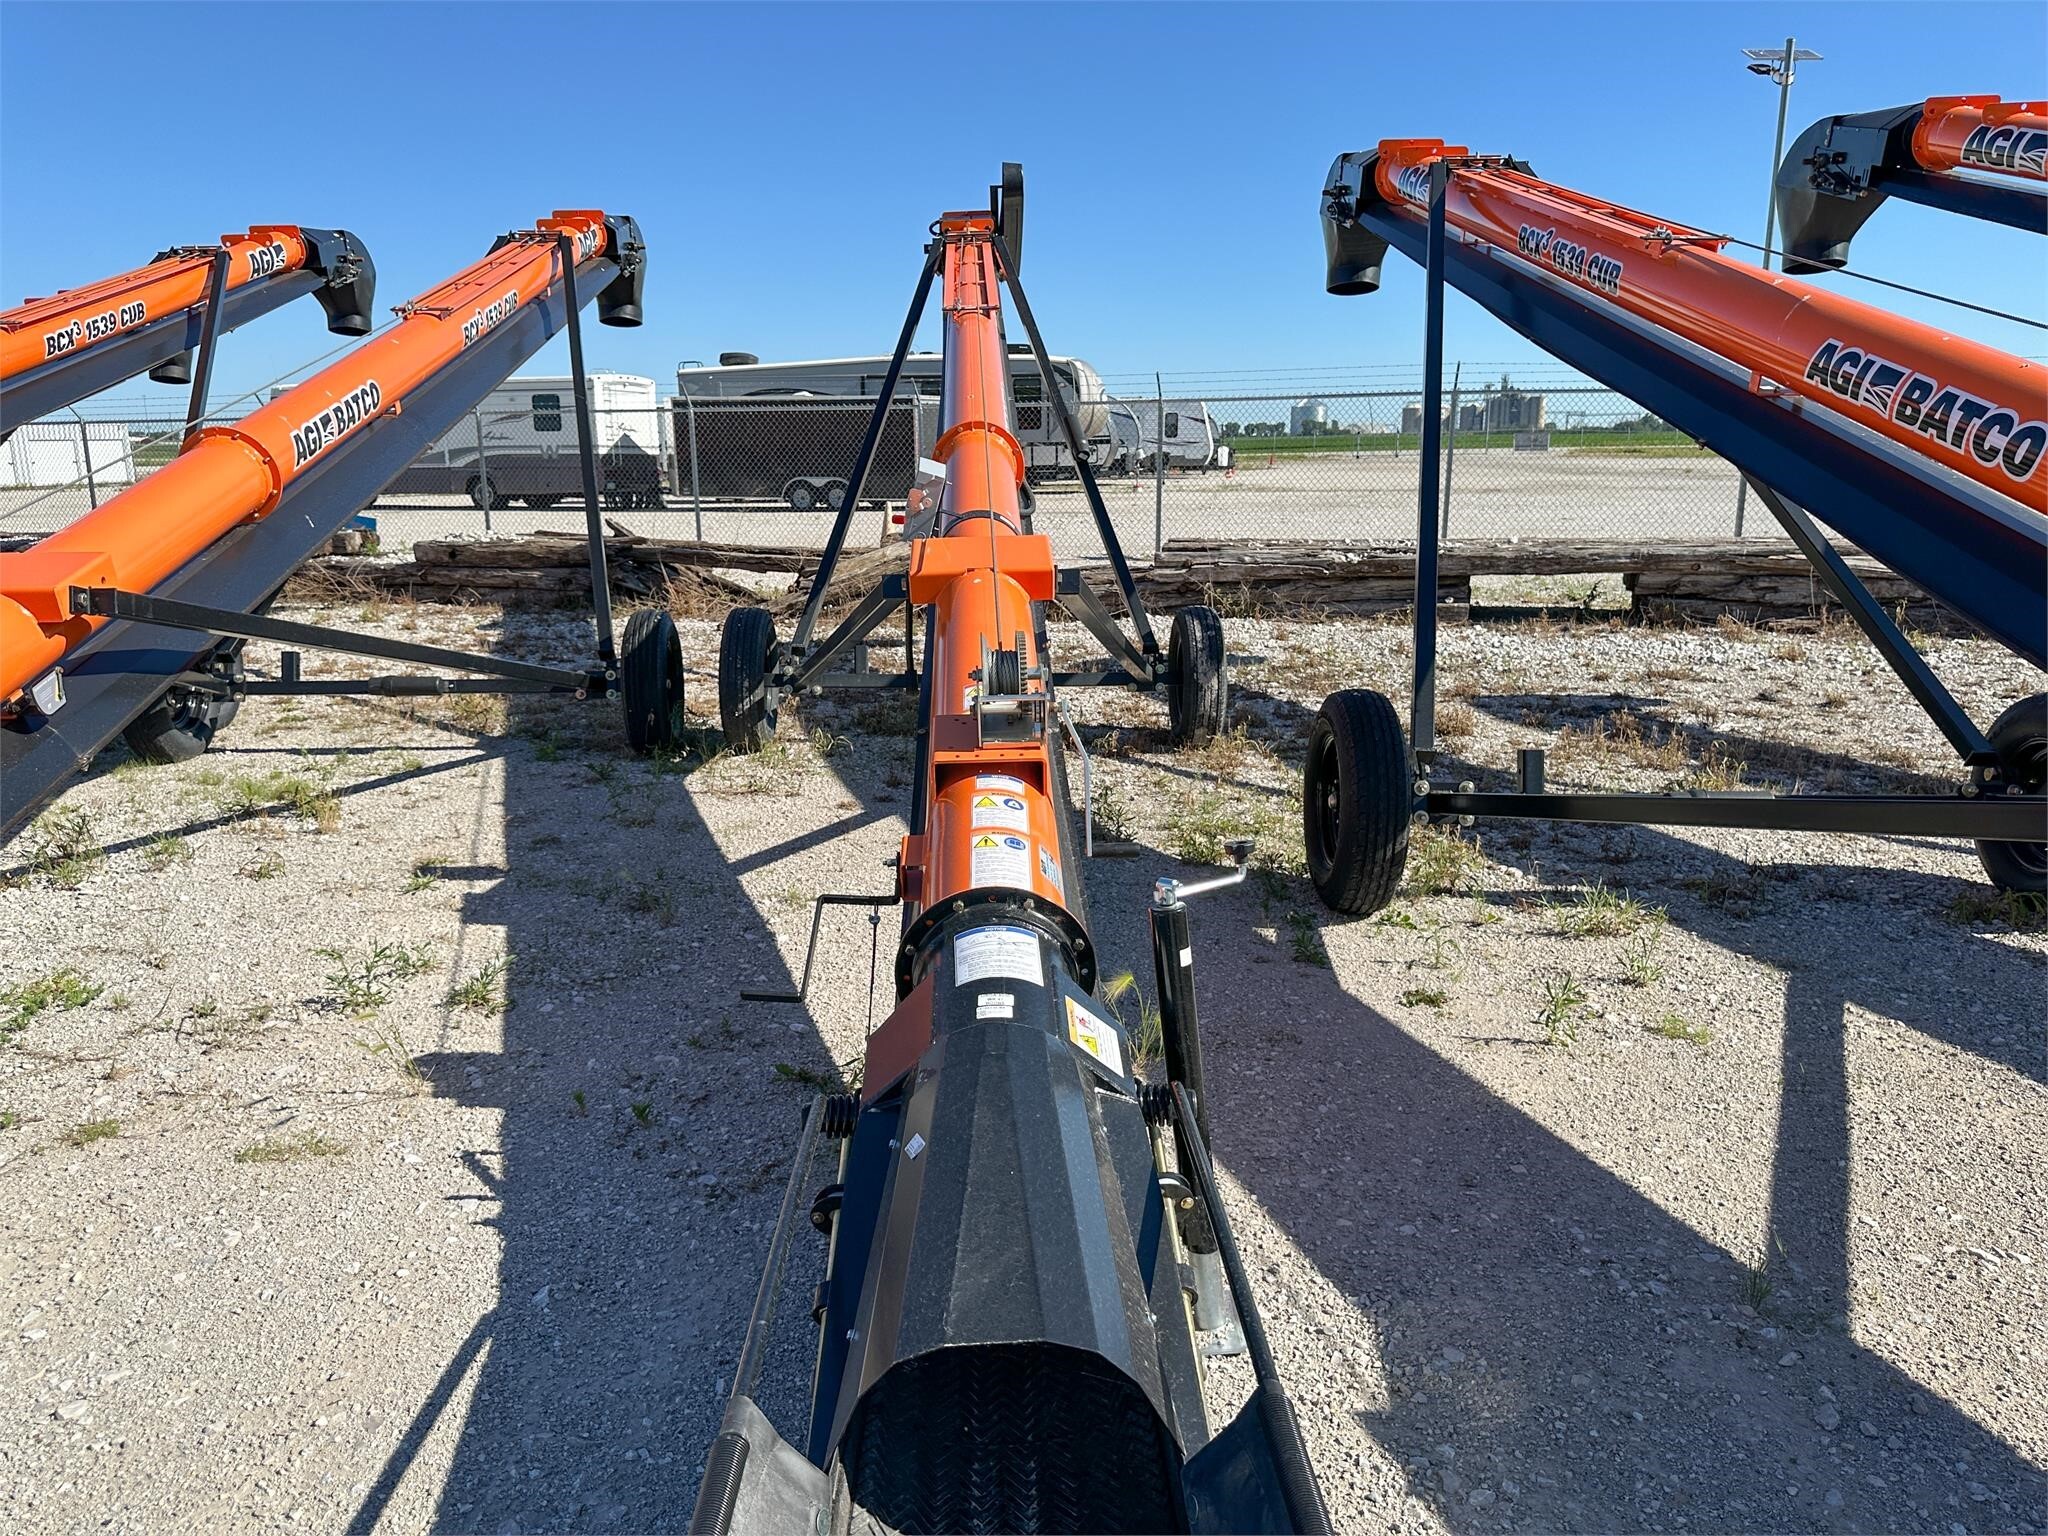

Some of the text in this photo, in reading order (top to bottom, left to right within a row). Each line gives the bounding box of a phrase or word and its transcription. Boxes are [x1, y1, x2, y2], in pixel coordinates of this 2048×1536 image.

[1961, 125, 2030, 170] AGI
[1397, 165, 1426, 202] AGI
[248, 245, 275, 280] AGI
[1550, 240, 1587, 280] 1539
[85, 312, 117, 342] 1539
[120, 301, 146, 328] CUB
[292, 381, 381, 468] AGI BATCO
[1805, 340, 2048, 478] AGI BATCO
